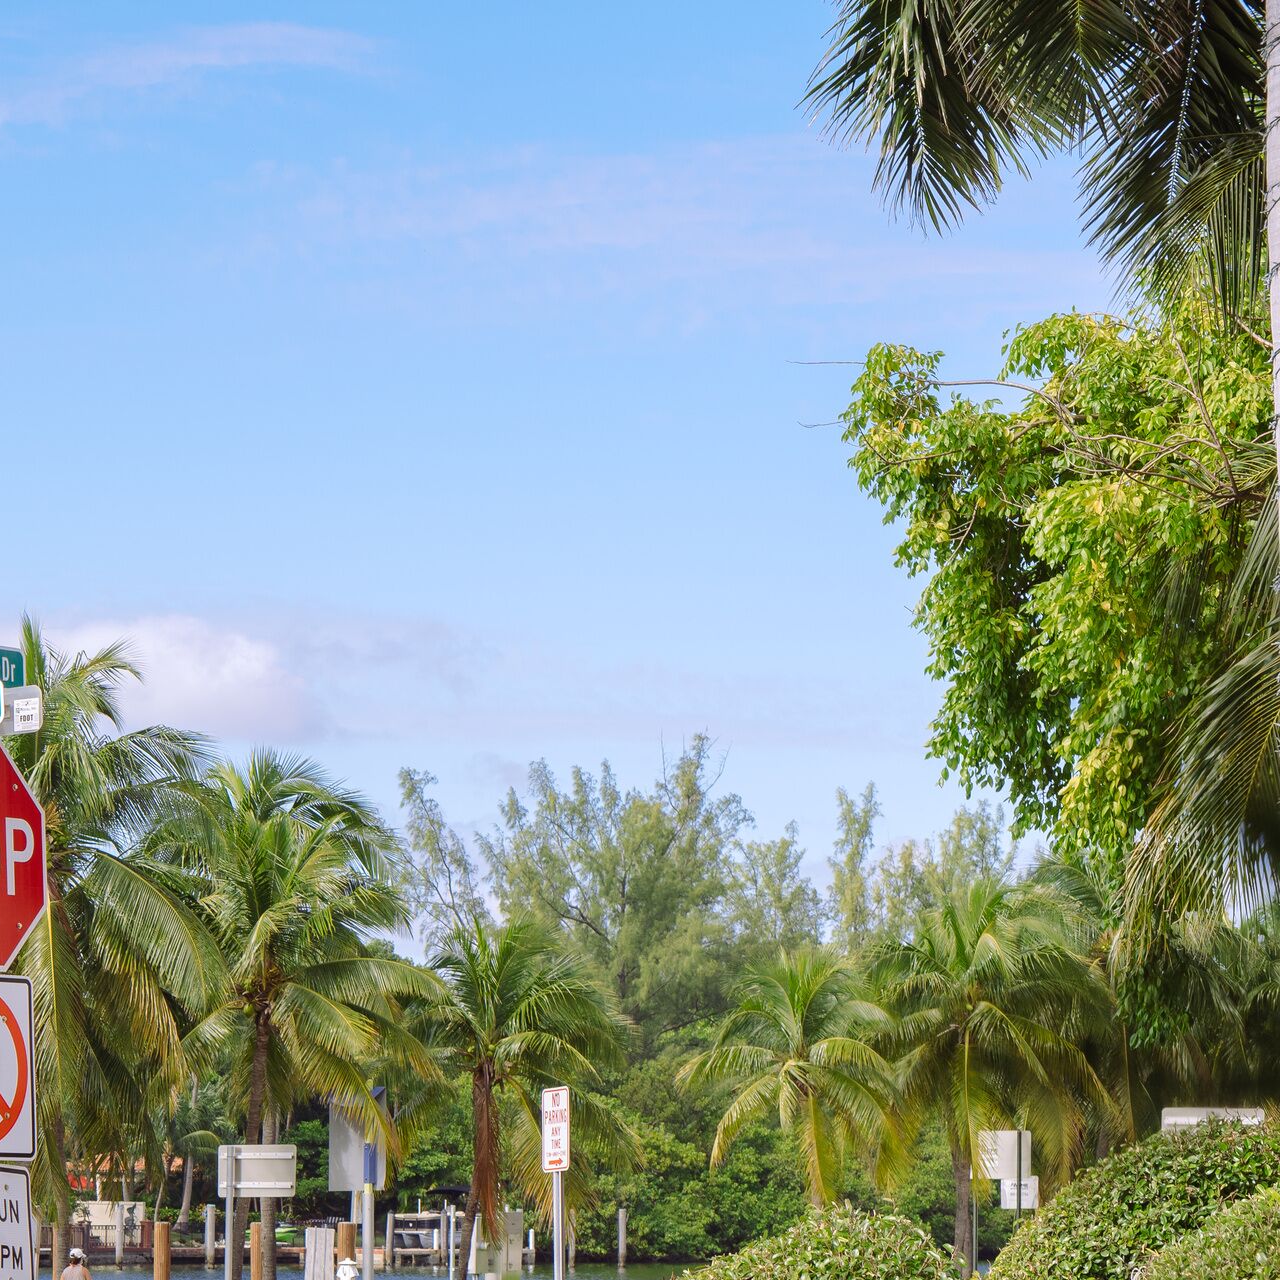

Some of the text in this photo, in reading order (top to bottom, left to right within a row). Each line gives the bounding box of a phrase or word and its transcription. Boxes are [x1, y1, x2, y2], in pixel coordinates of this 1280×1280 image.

[2, 656, 16, 683] Dr
[552, 1093, 561, 1107] NO
[545, 1108, 567, 1124] PARKING
[551, 1127, 561, 1136] ANY
[552, 1139, 561, 1149] TIME
